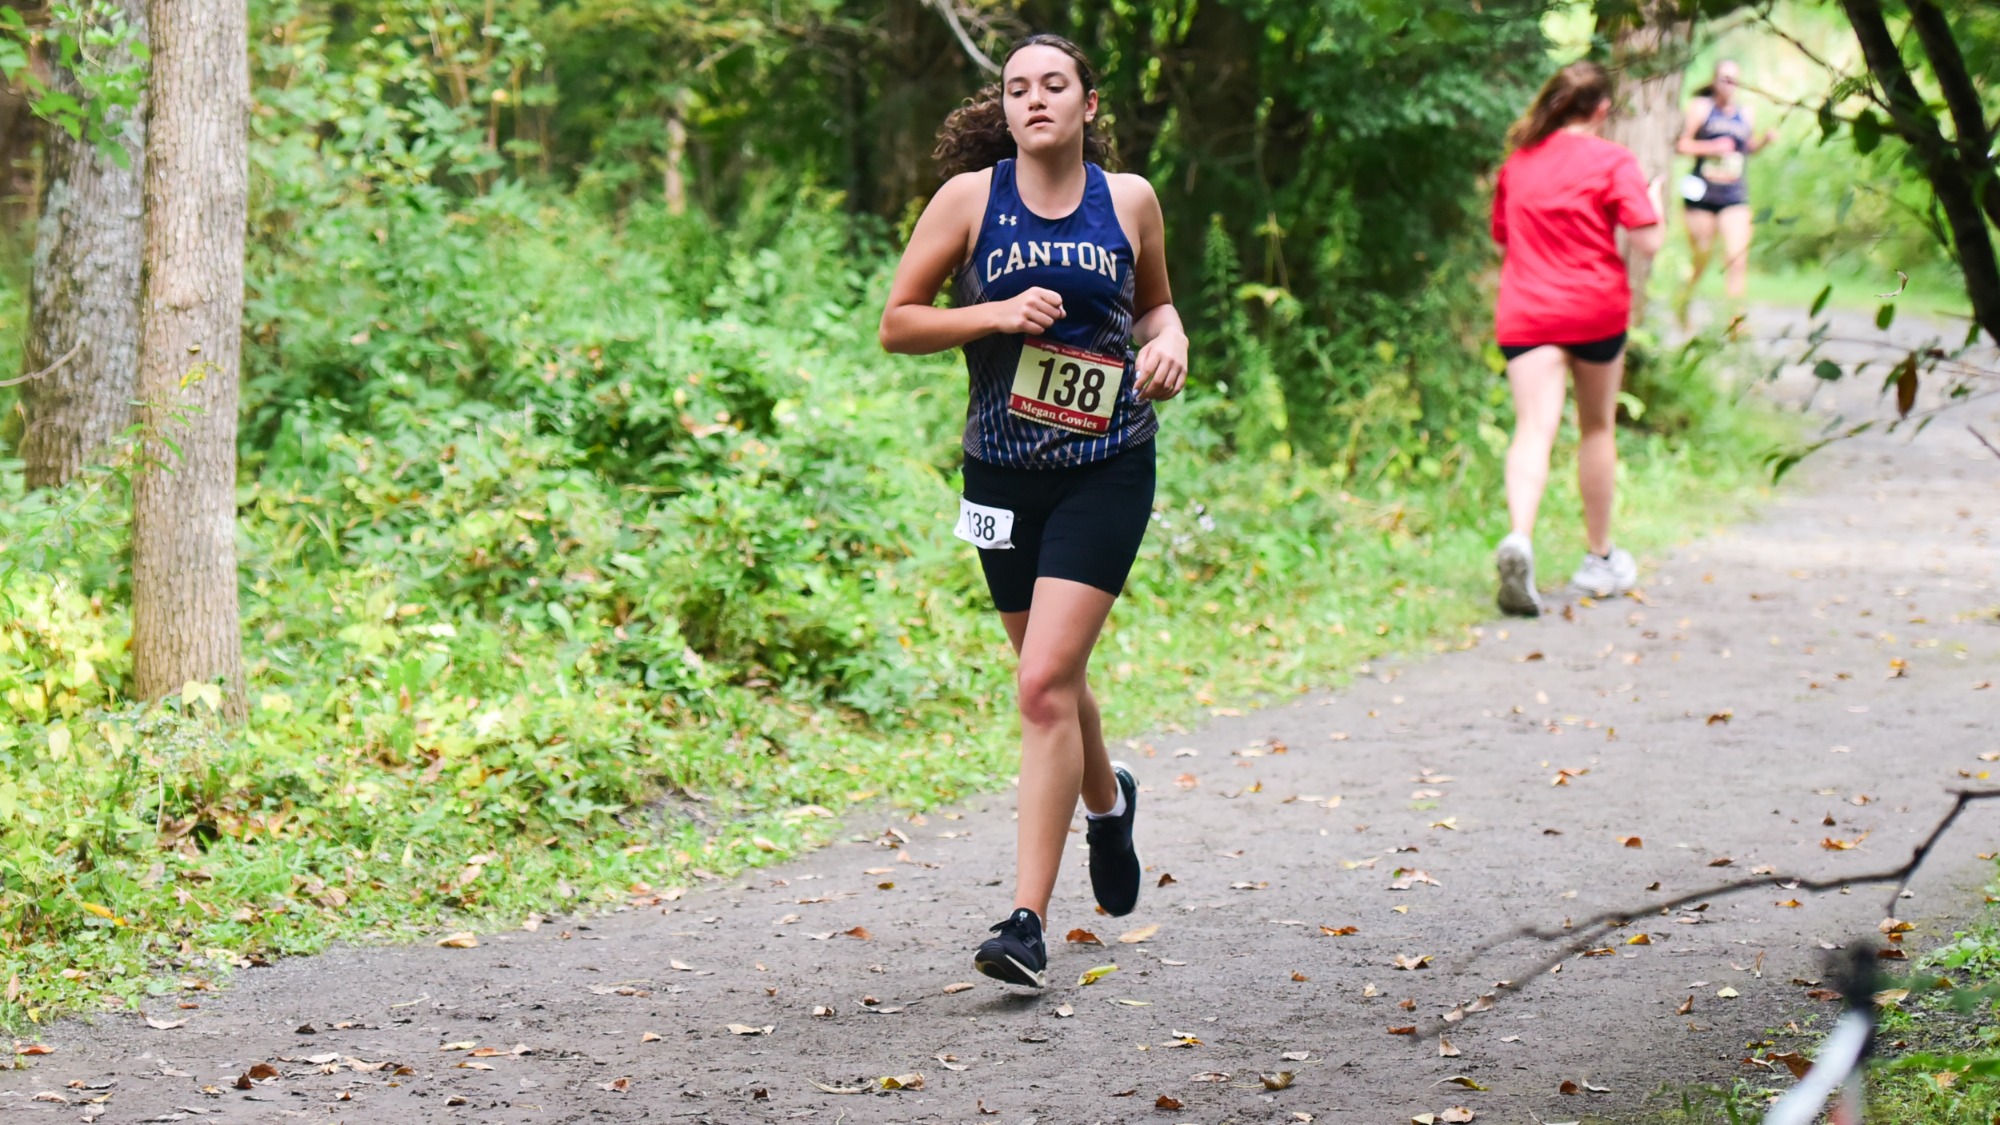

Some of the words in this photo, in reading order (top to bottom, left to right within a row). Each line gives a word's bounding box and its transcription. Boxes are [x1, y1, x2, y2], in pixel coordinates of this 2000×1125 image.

[987, 241, 1117, 282] CANTON
[1038, 358, 1105, 413] 138
[1020, 400, 1056, 419] Megan
[1058, 412, 1097, 429] Cowles
[967, 510, 995, 541] 138
